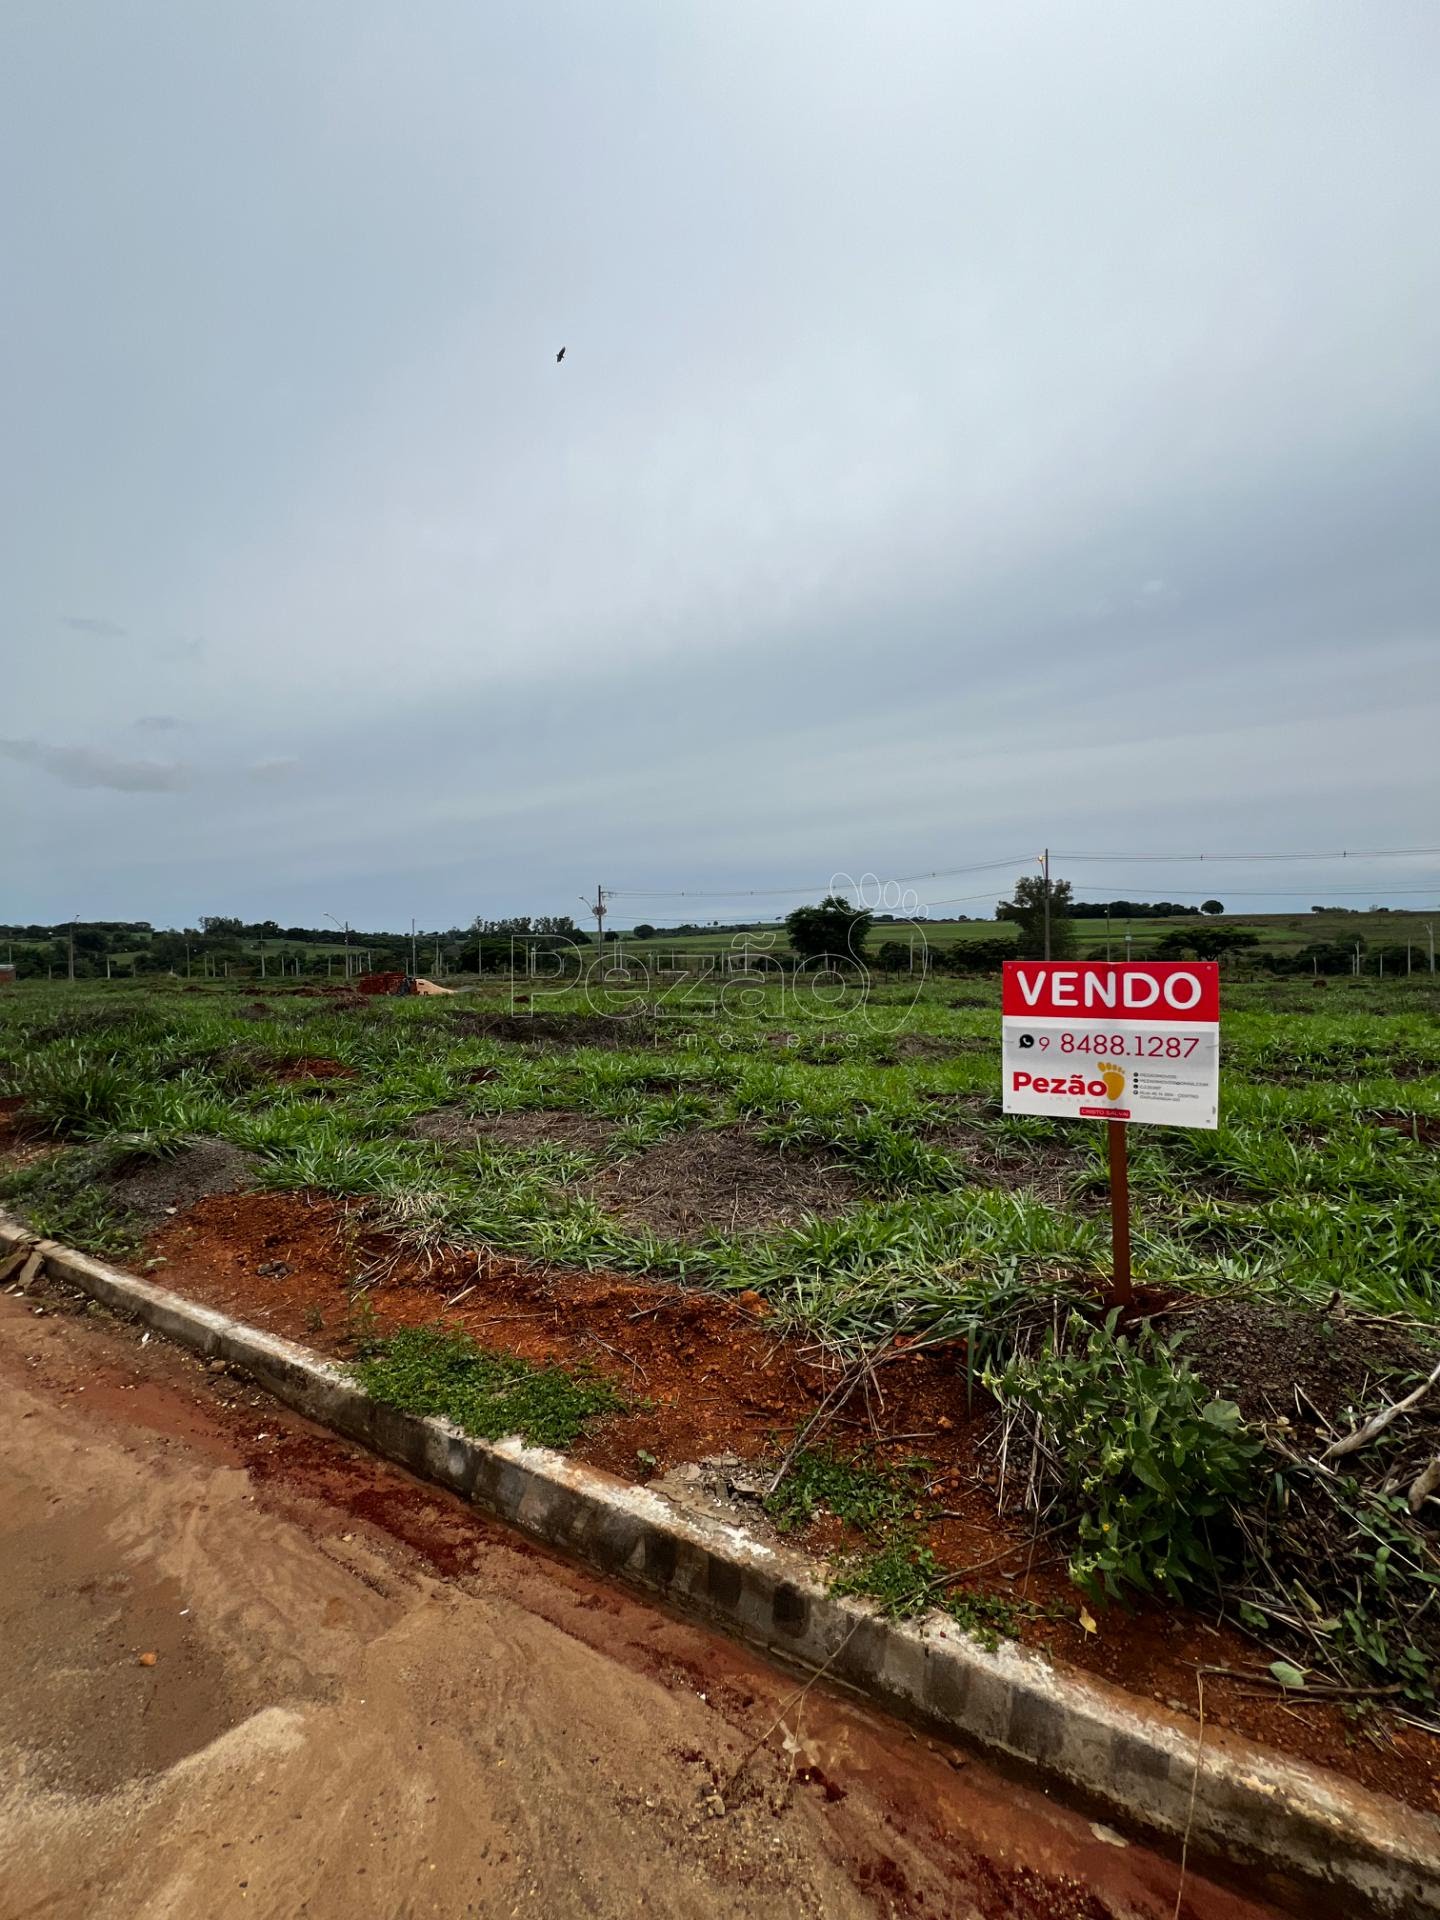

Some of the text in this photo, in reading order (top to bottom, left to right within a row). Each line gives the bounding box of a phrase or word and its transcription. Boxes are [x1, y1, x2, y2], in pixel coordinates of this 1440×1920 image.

[1016, 970, 1202, 1010] VENDO
[1038, 1032, 1200, 1059] 9 8488.1287
[1012, 1071, 1108, 1097] Pezão
